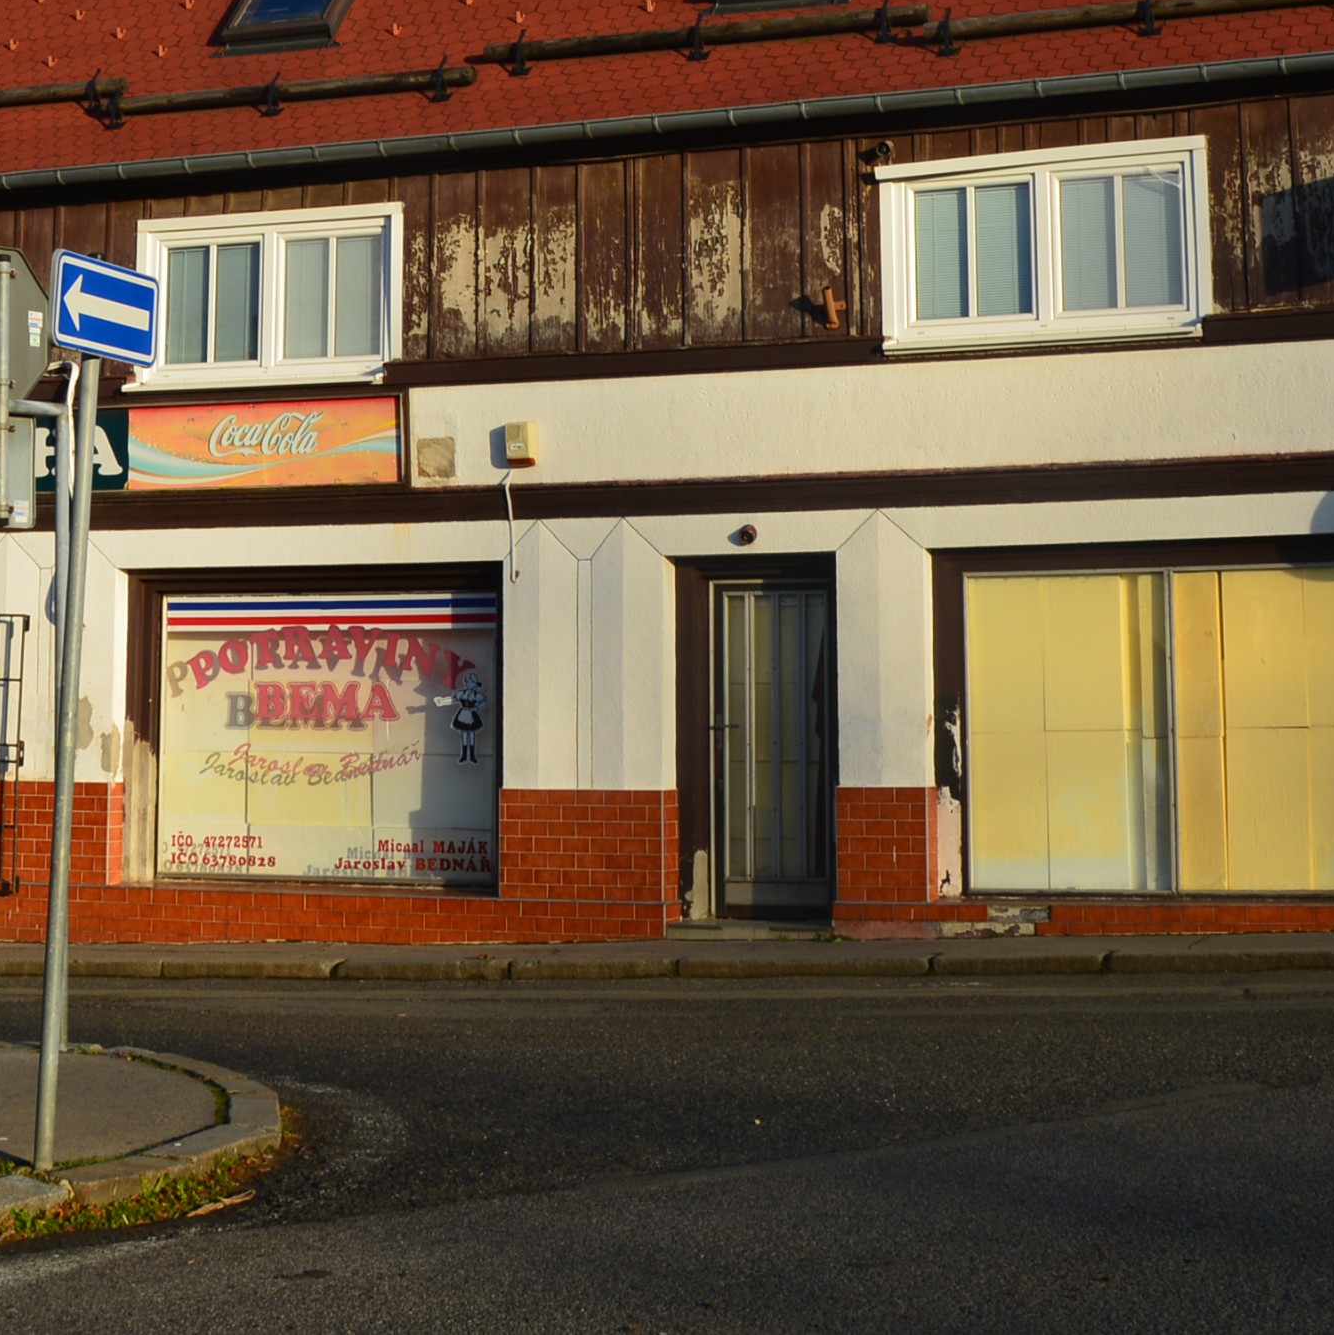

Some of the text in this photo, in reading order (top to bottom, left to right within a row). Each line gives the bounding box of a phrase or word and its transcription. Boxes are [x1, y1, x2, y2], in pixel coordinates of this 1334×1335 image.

[208, 410, 325, 458] Coca-Cola
[186, 623, 476, 689] POTRAVINY
[254, 681, 401, 722] BEMA
[171, 831, 263, 848] IČO 47272571
[432, 836, 488, 854] MAJÁK
[171, 848, 276, 868] IČO 63780828
[334, 857, 407, 871] Jaroslav
